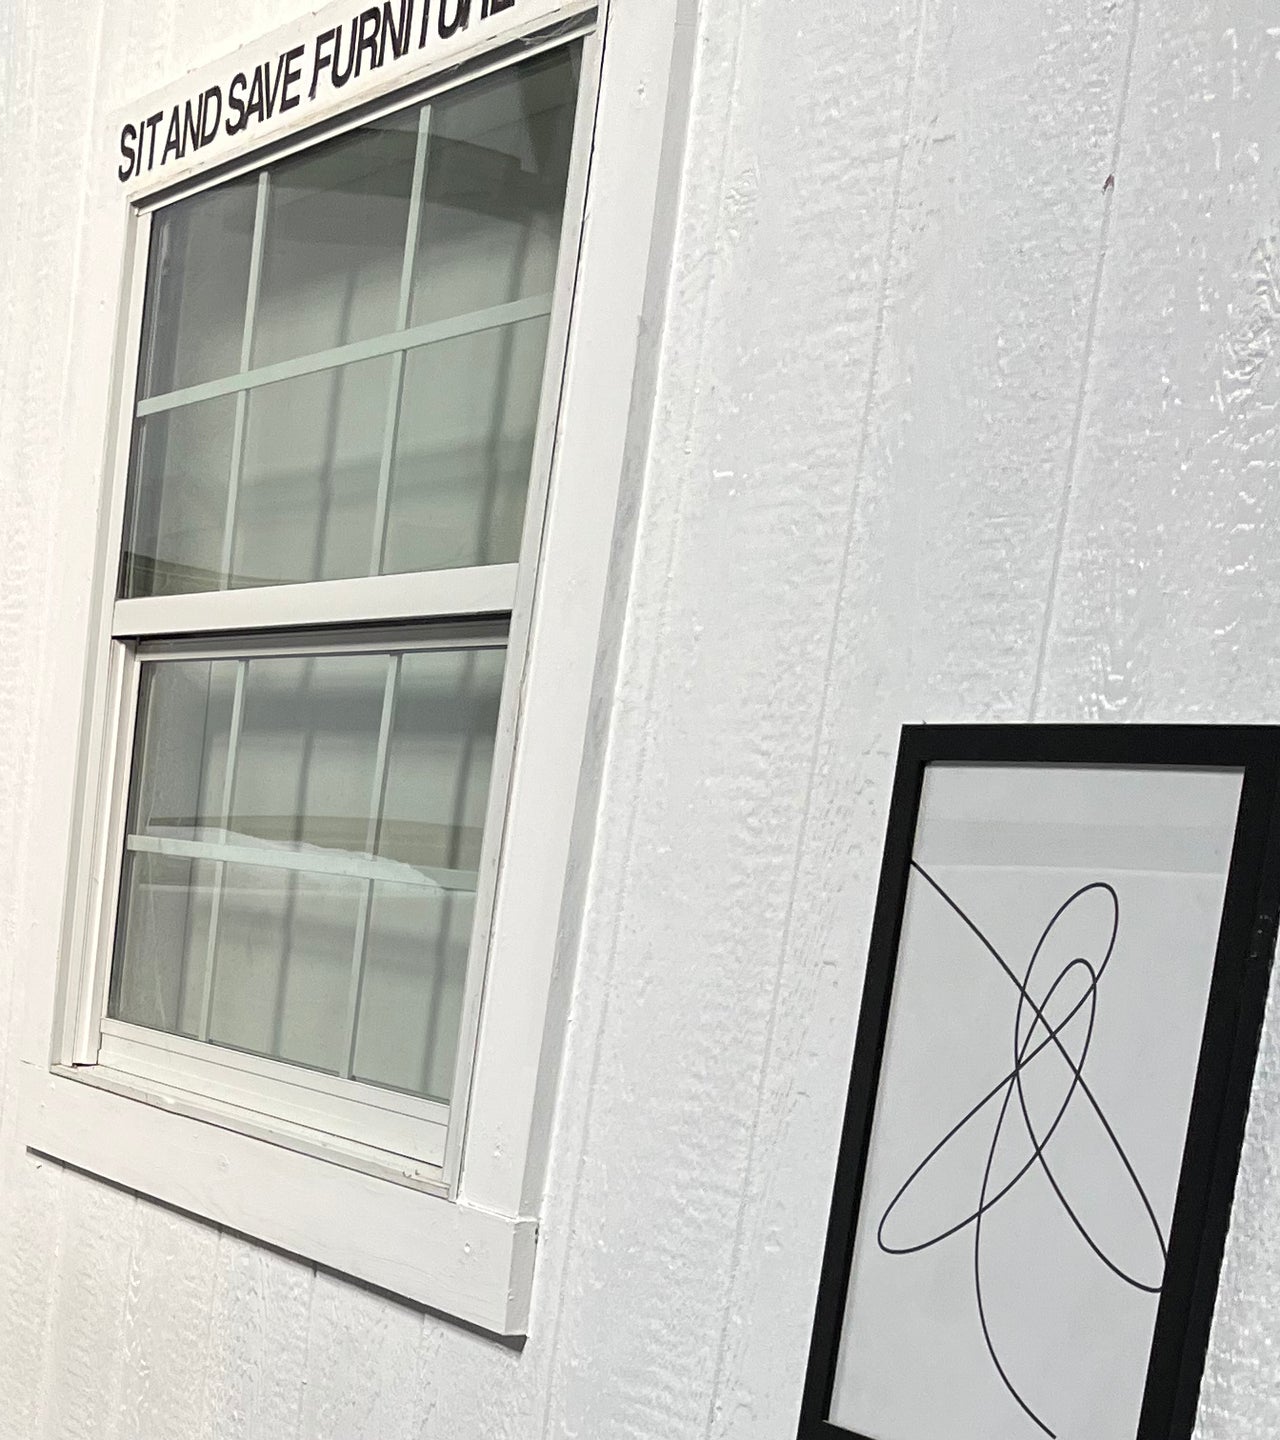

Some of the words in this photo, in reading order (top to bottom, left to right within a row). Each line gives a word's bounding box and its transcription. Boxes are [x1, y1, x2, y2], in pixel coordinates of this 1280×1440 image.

[118, 110, 164, 183] SIT
[160, 85, 222, 166] AND
[224, 44, 305, 136] SAVE
